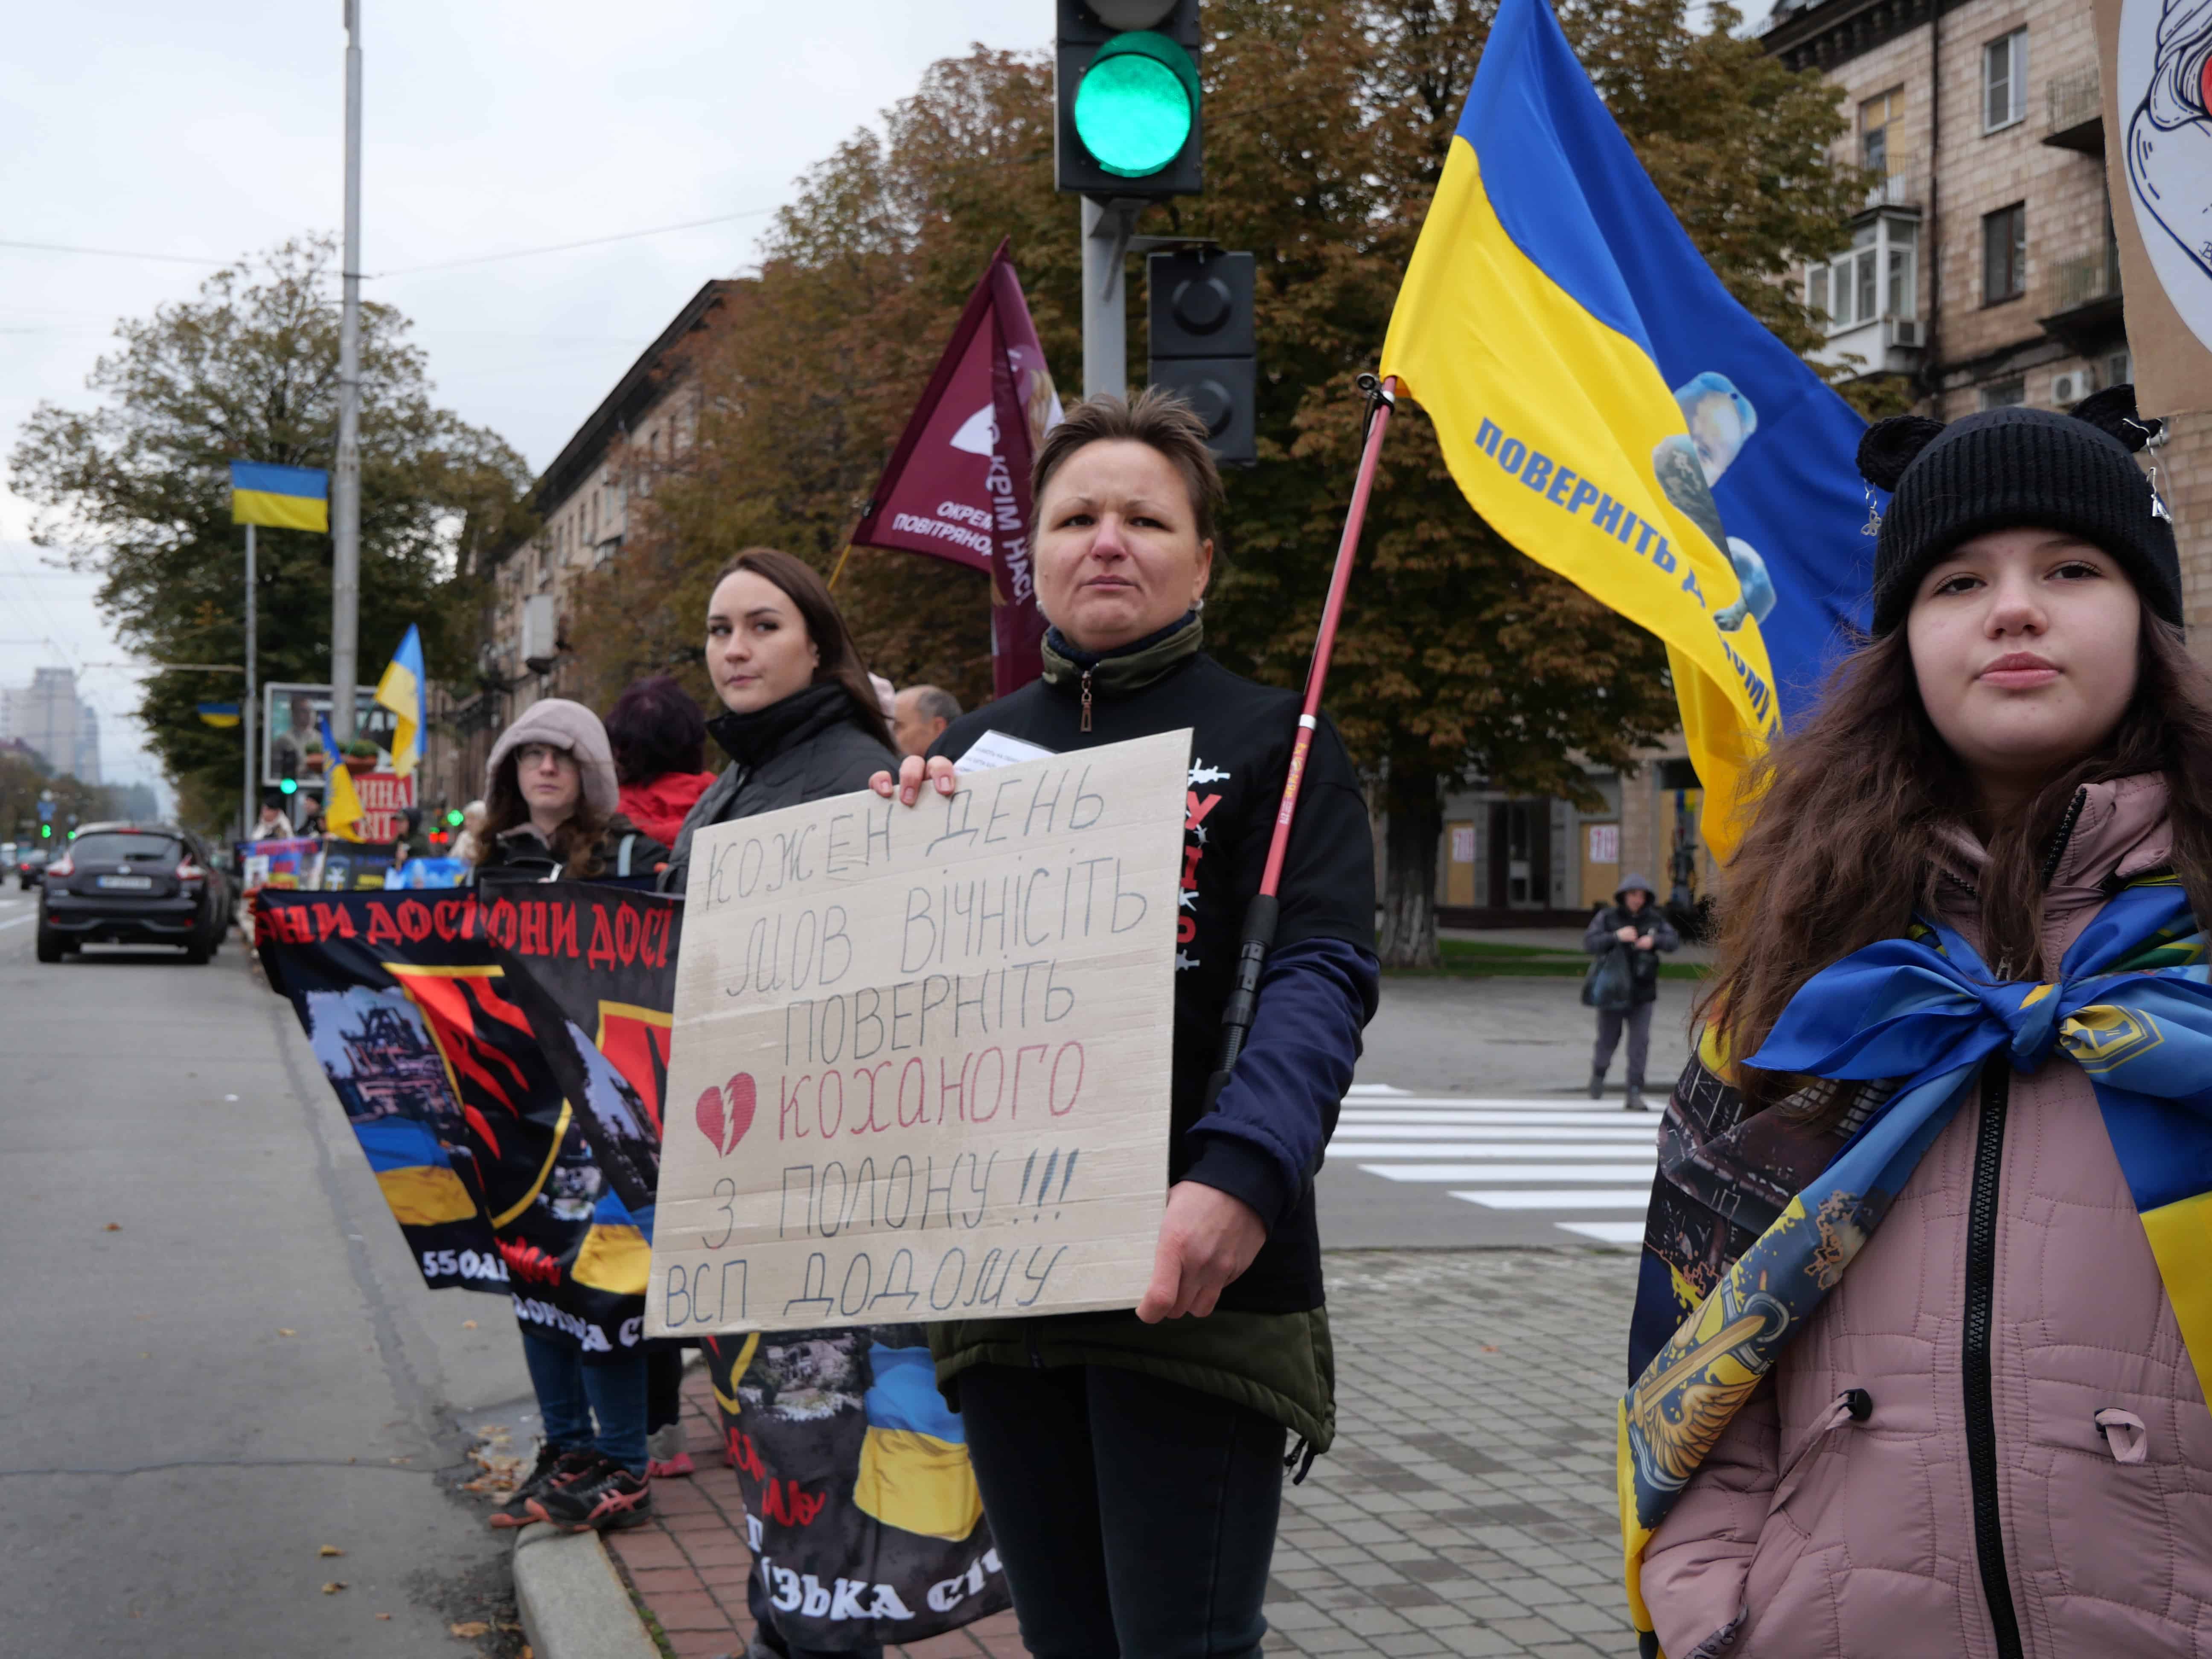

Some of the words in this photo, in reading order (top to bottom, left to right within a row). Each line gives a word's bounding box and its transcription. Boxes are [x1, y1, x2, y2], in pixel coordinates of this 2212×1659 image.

[986, 455, 1022, 531] КРІМ
[1474, 416, 1677, 574] ПОВЕРНІТЬ
[1002, 536, 1033, 605] НАС!
[706, 803, 894, 911] КОЖЕН
[926, 764, 1105, 857] ДЕНЬ
[365, 892, 478, 946] ДОСІ
[587, 898, 674, 972] ДОСІ
[785, 954, 1076, 1066] ПОВЕРНІТЬ
[778, 1040, 1085, 1141] КОХАНОГО
[779, 1150, 1001, 1238] ПОЛОНУ
[666, 1259, 748, 1327] ВСП
[783, 1244, 1069, 1317] ДОДОМУ
